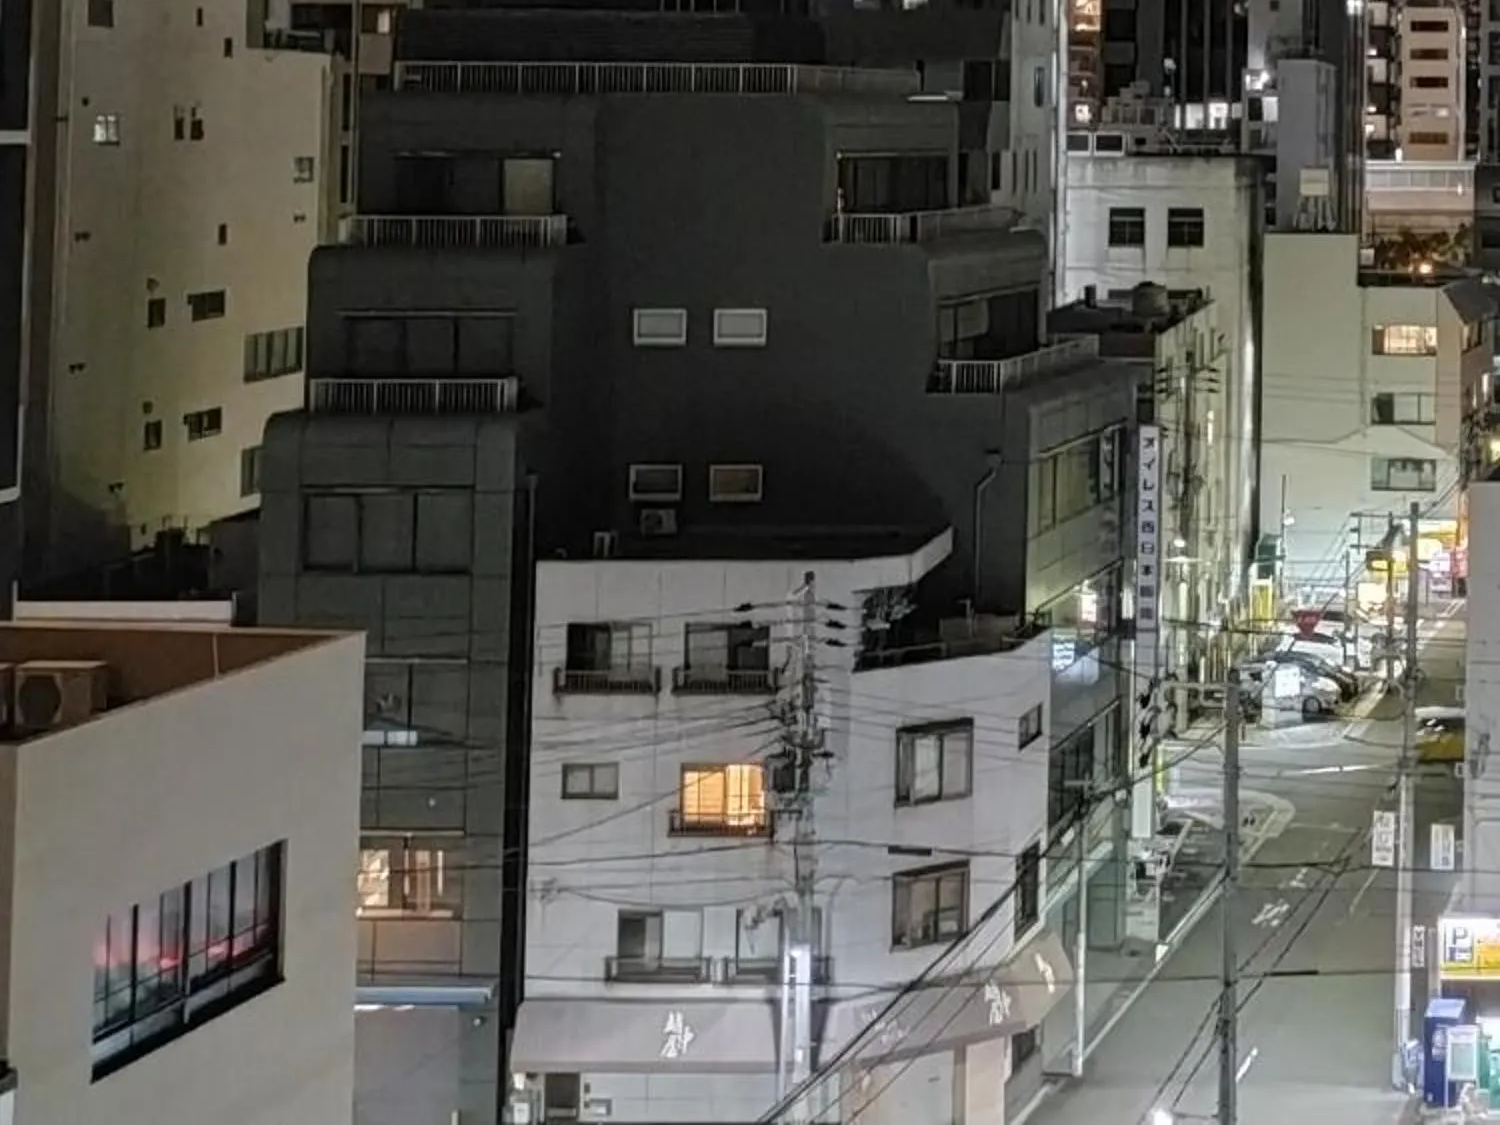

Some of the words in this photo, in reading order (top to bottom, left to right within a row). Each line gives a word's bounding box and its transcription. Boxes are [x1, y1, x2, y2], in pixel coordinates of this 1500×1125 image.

[1139, 435, 1156, 620] オイレス西日本
[1452, 926, 1468, 945] P
